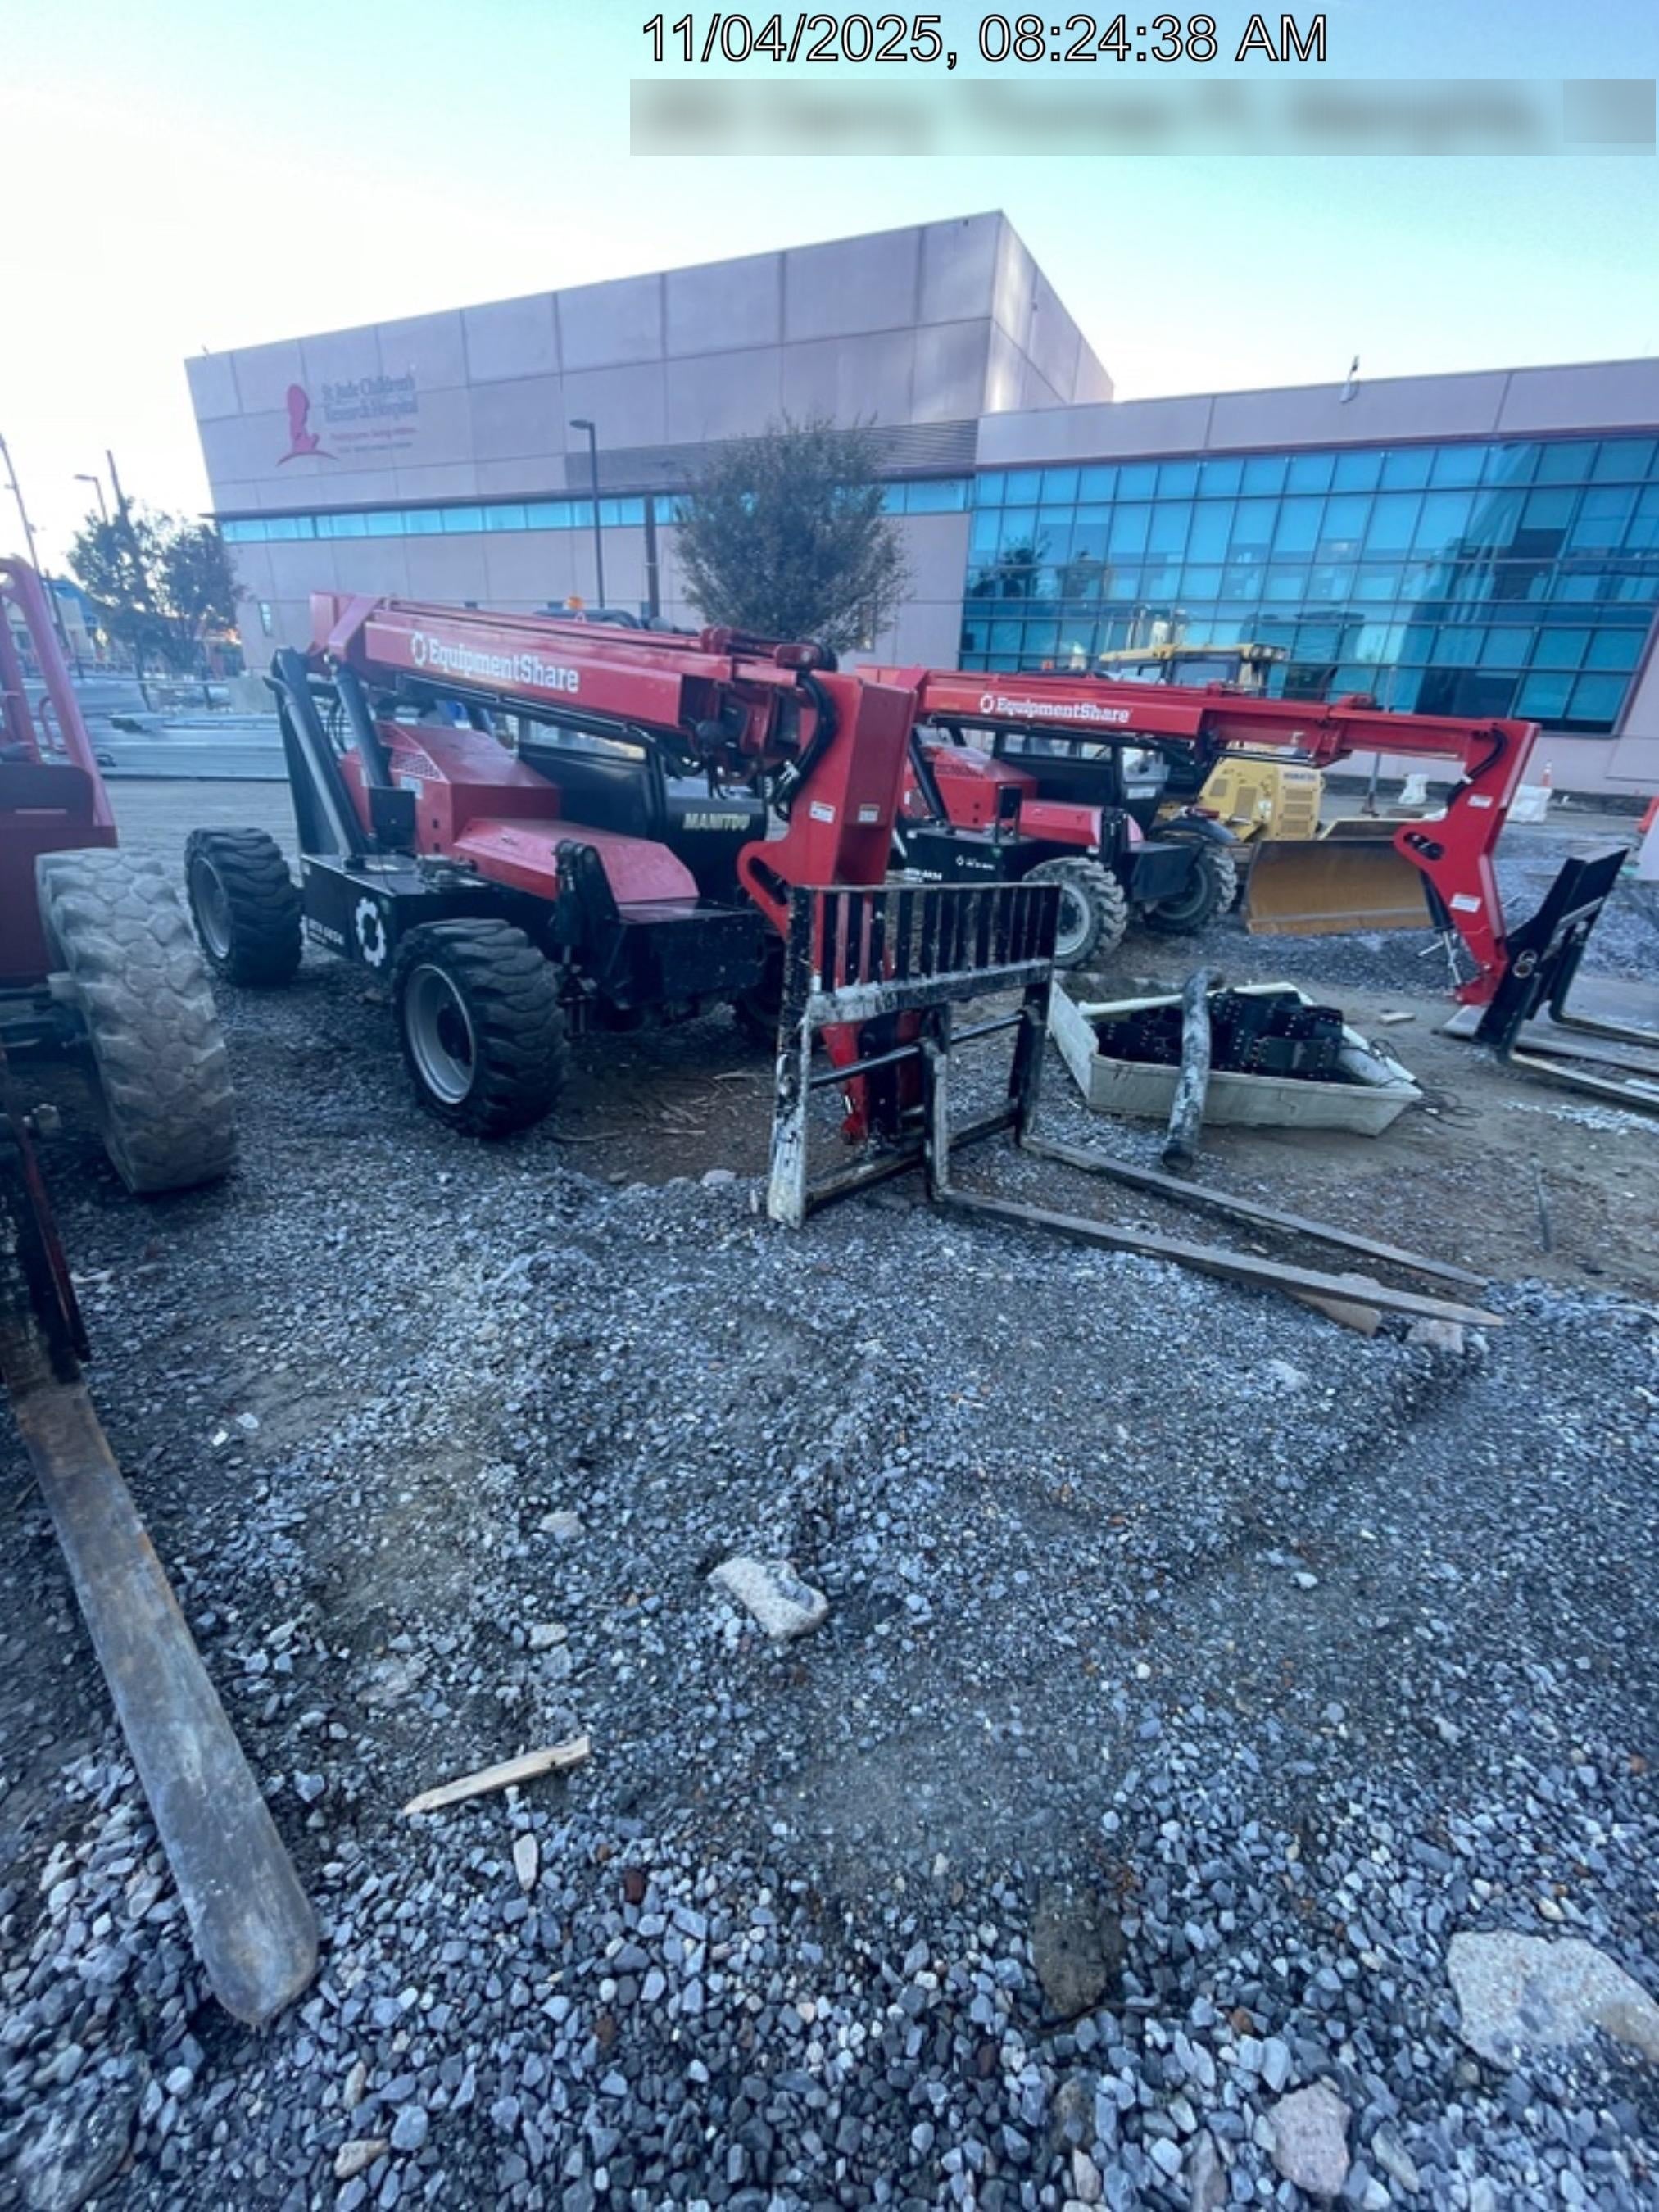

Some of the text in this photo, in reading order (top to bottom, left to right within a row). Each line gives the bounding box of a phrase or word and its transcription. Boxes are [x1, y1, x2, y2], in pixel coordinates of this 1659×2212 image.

[428, 638, 580, 693] EquipmentShare
[996, 697, 1130, 723] EquipmentShare
[682, 812, 751, 832] MANITOU
